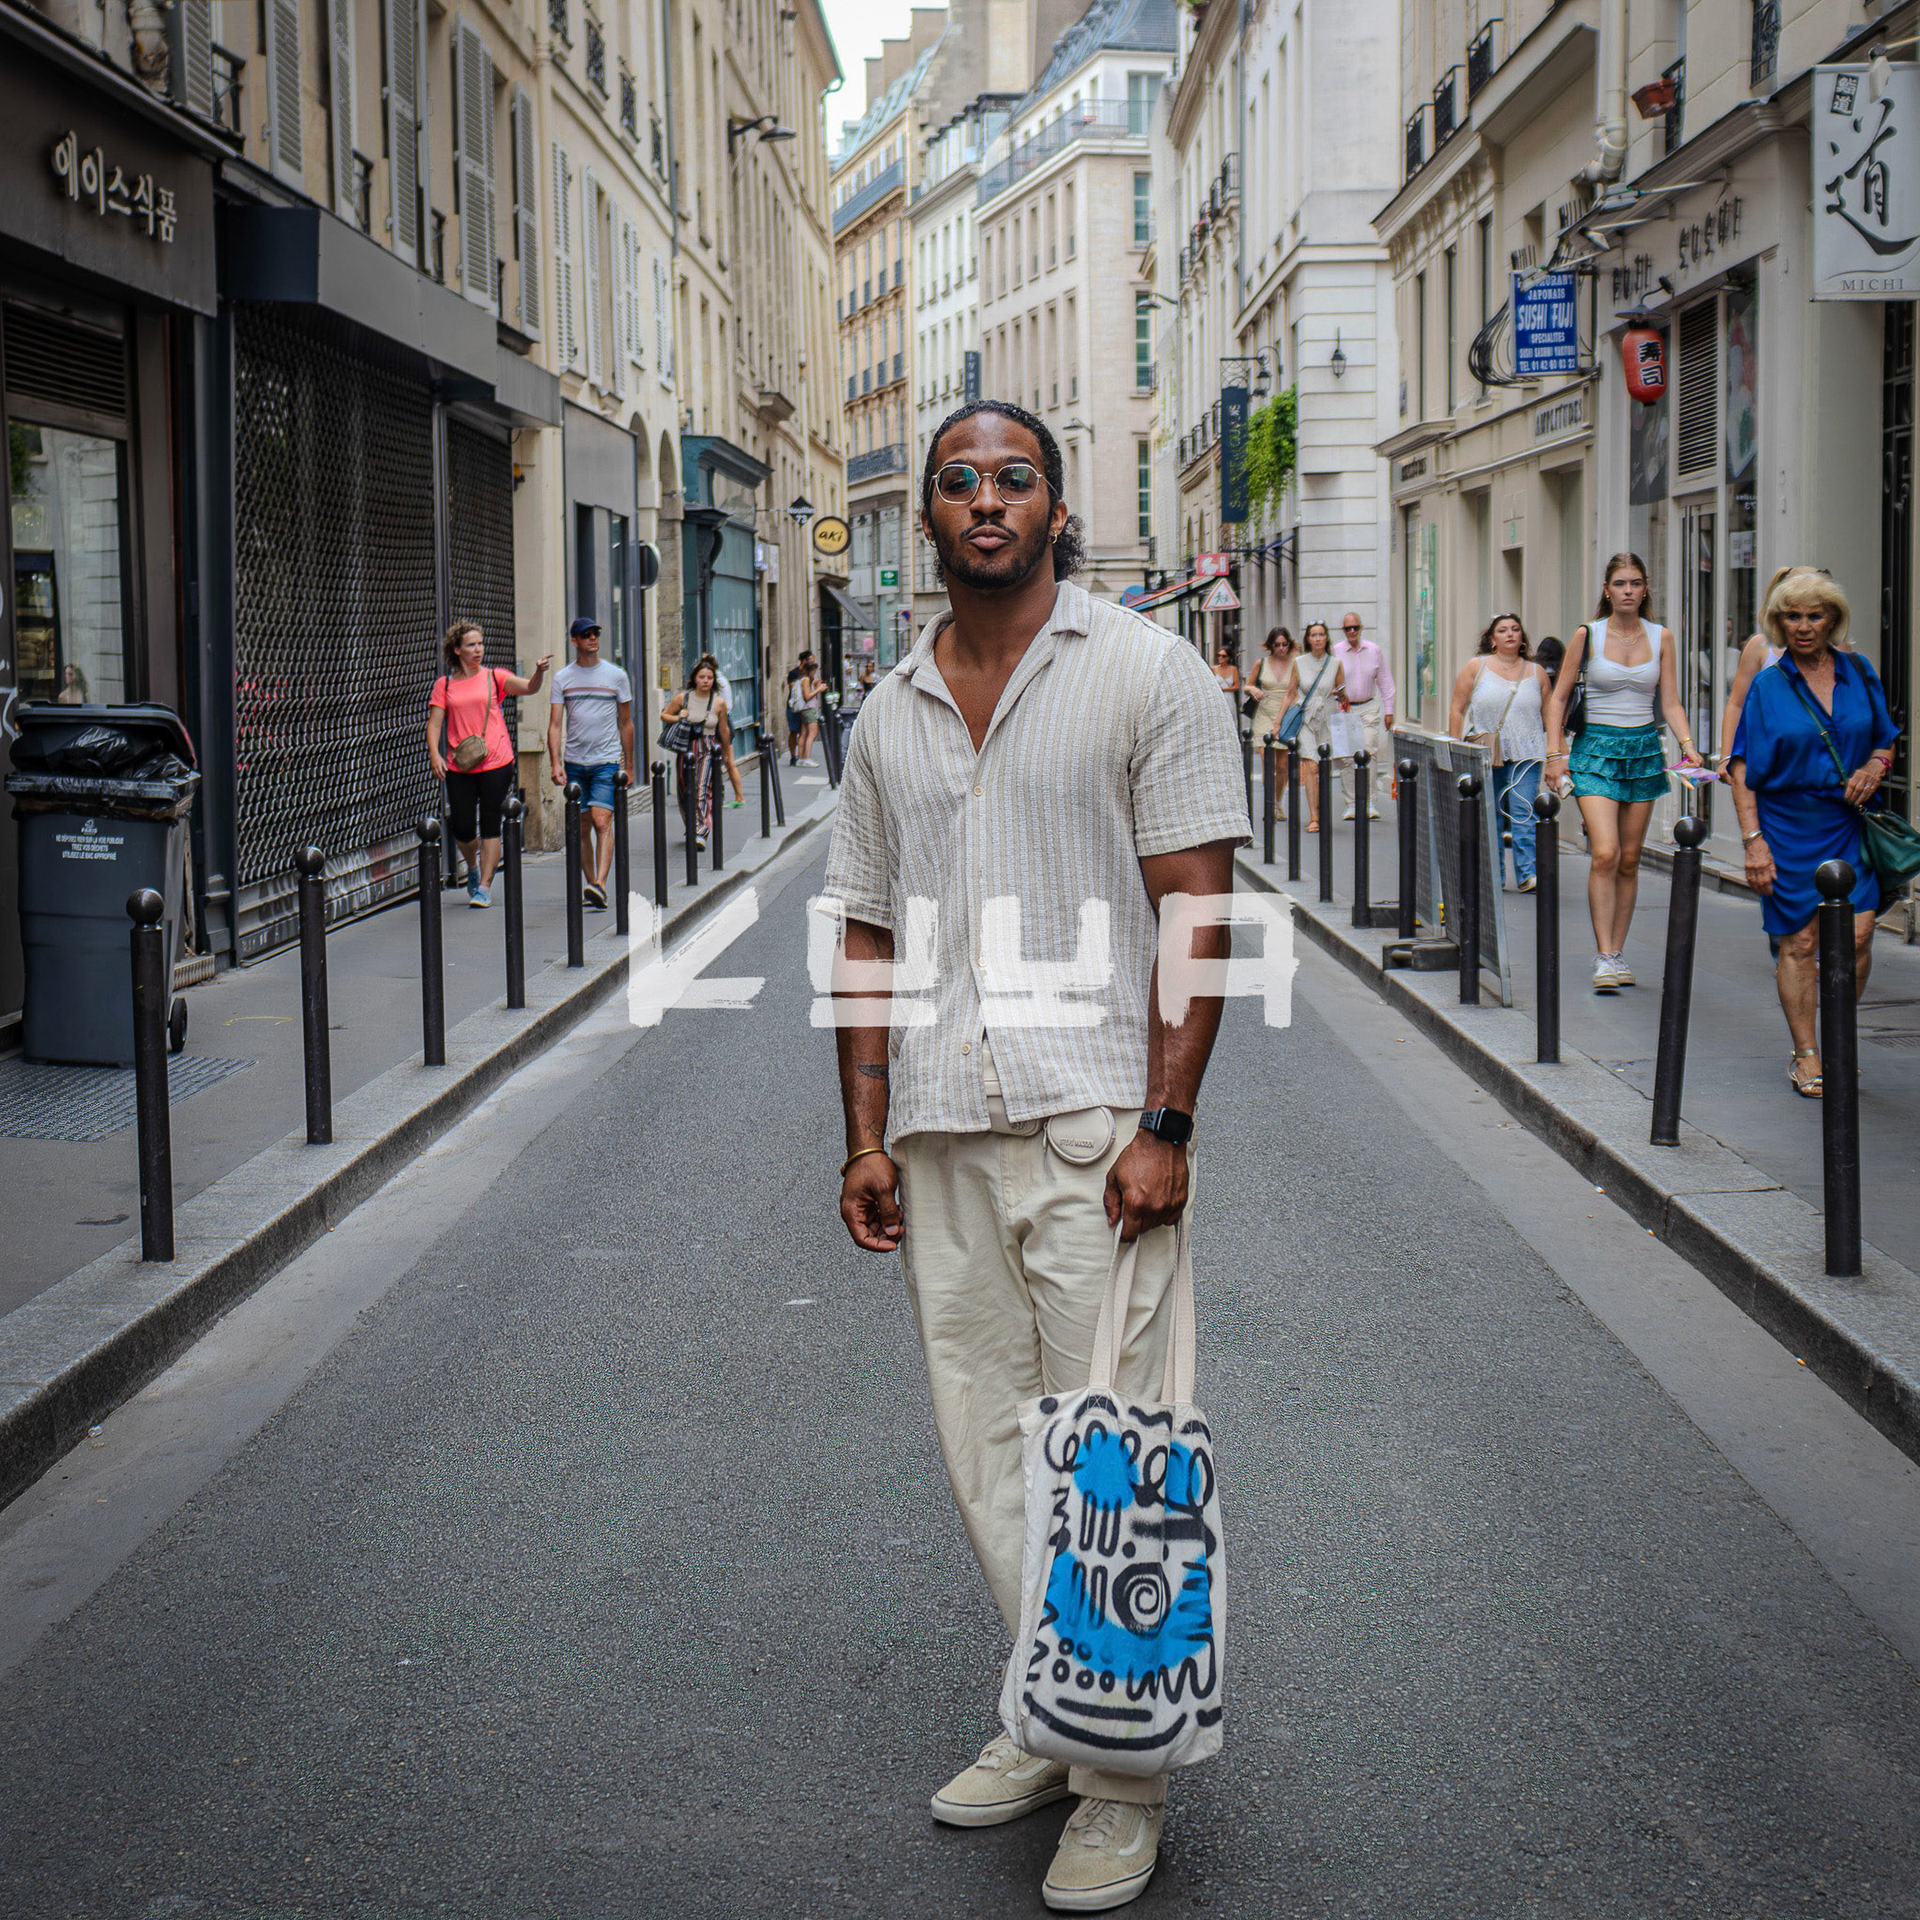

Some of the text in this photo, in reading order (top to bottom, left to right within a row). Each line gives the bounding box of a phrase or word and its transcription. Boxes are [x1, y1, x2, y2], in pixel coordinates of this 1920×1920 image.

[55, 130, 178, 243] 에이스식품
[1527, 288, 1566, 300] JAPONAIS
[1841, 279, 1905, 292] MICHI
[1518, 302, 1575, 331] SUSHI FUJI
[1638, 341, 1664, 386] 寿司
